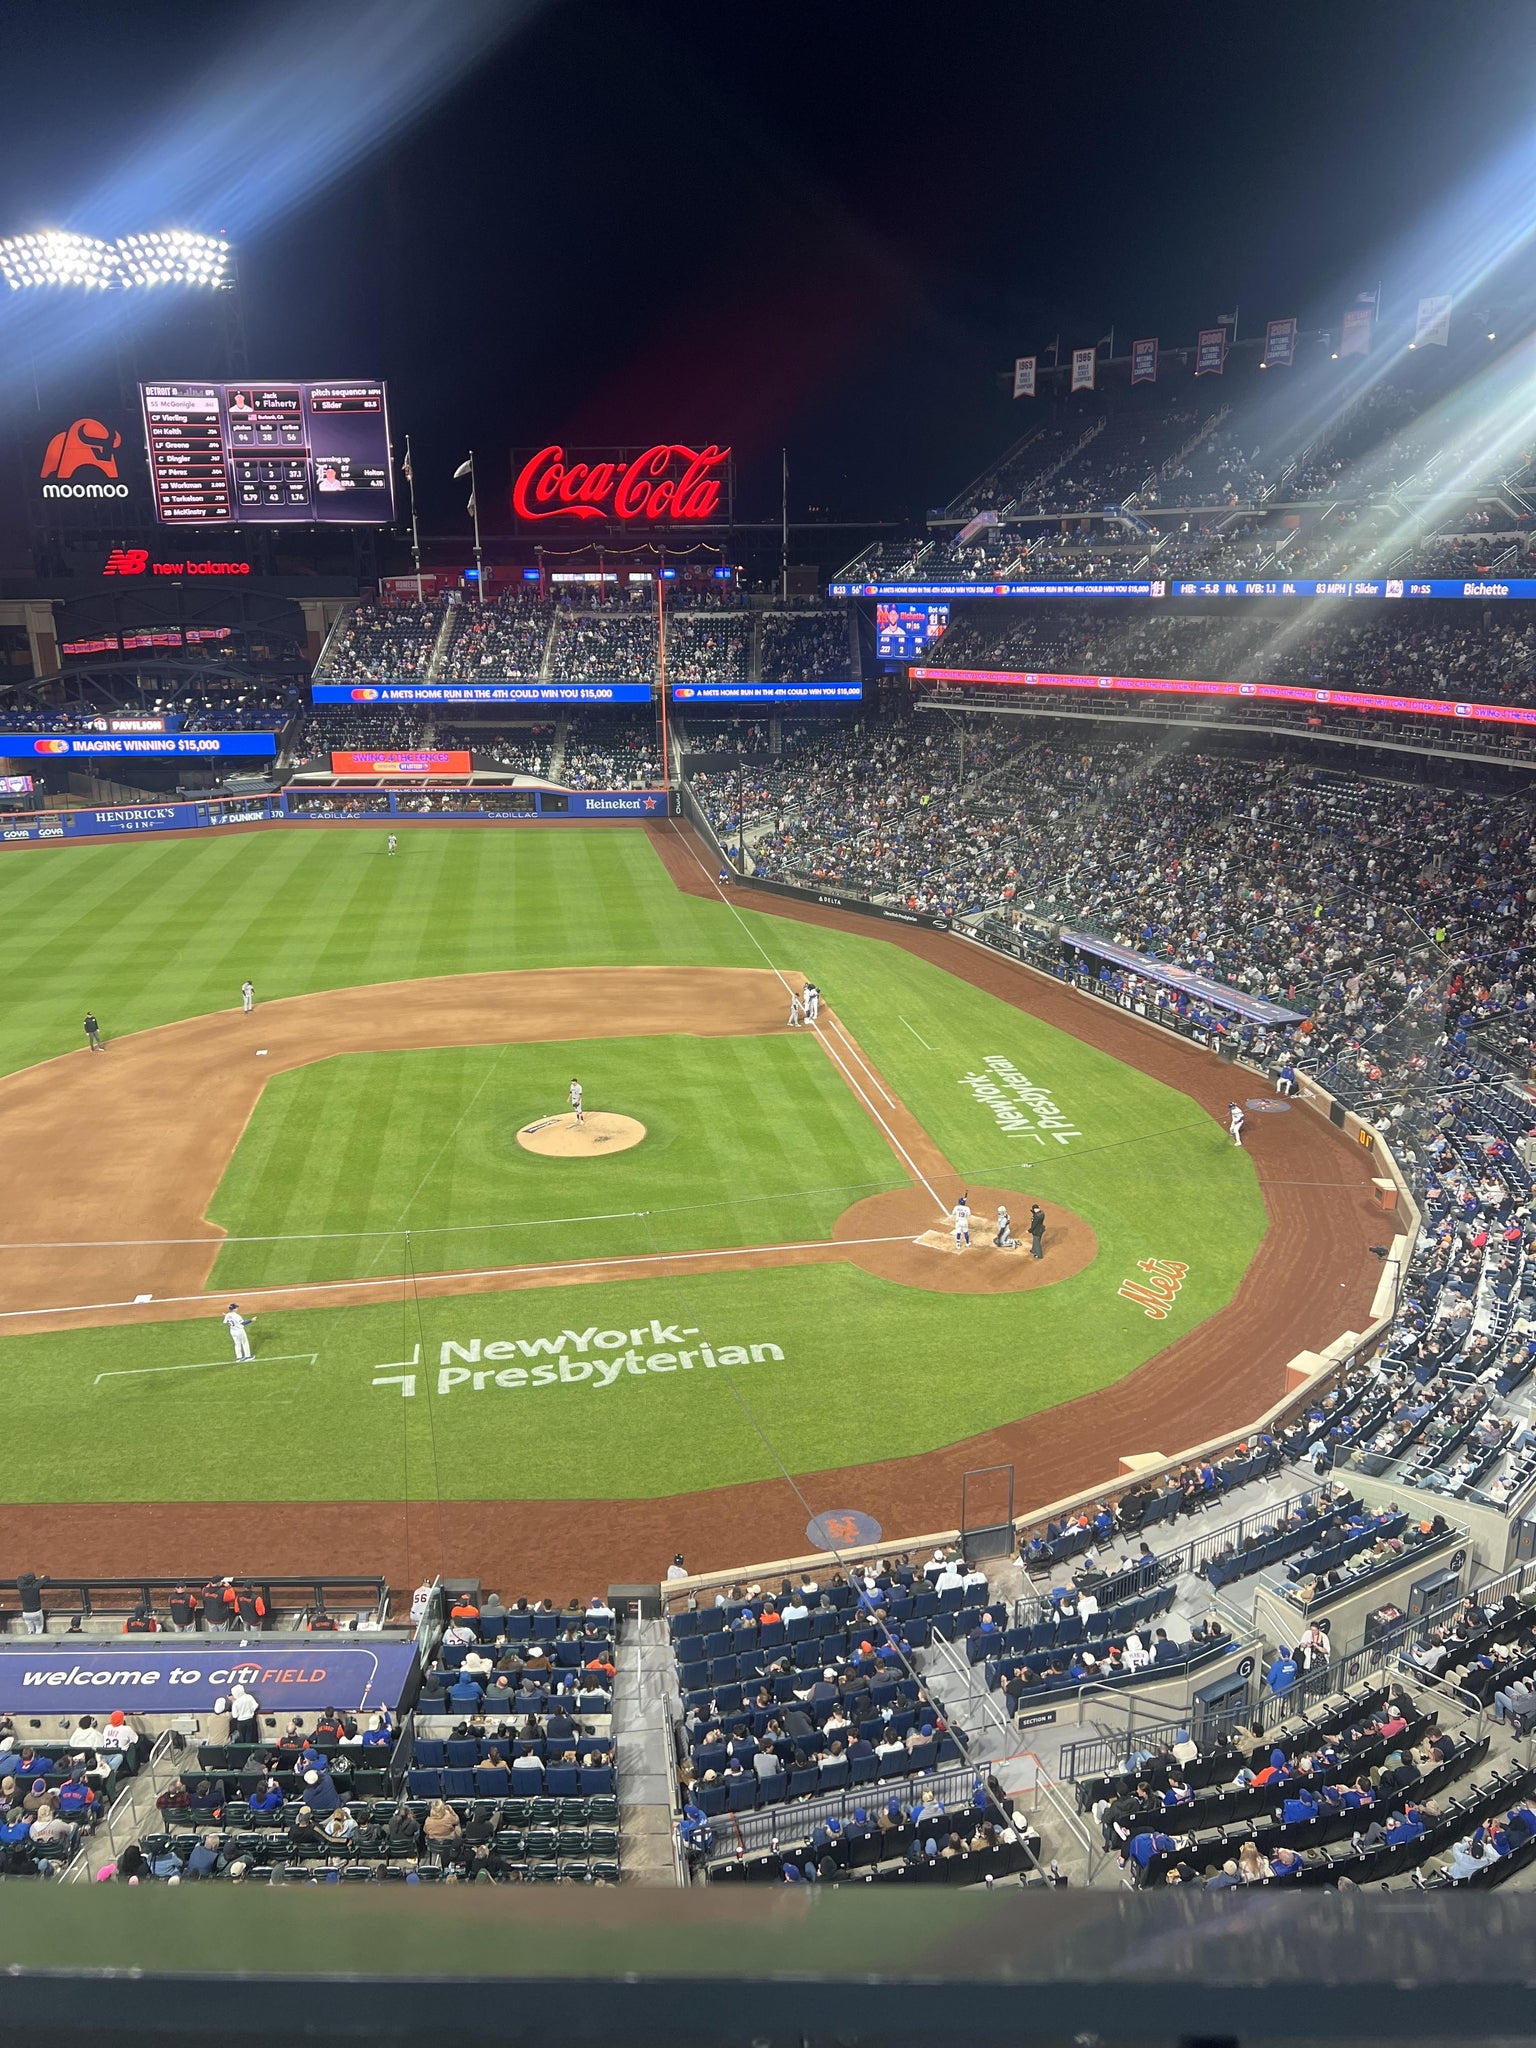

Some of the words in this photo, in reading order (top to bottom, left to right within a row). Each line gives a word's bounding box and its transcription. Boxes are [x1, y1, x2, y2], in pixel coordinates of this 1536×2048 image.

[146, 387, 170, 395] DETROIT
[311, 389, 330, 398] pitch
[332, 389, 367, 397] sequence
[160, 401, 195, 409] McGonigle
[263, 400, 297, 409] Flaherty
[162, 415, 187, 423] Vierling
[513, 445, 731, 520] Coca-Cola
[43, 484, 129, 498] moomoo
[152, 563, 183, 574] new
[187, 561, 250, 575] balance
[833, 586, 846, 594] 8:33
[1181, 585, 1196, 594] HB:
[1225, 585, 1238, 594] IN.
[1283, 584, 1296, 594] IN.
[1316, 584, 1327, 594] 83
[1327, 584, 1346, 594] MPH
[1355, 584, 1379, 594] Slider
[1463, 584, 1508, 595] Bichette
[382, 690, 389, 699] A
[390, 690, 414, 699] METS
[415, 690, 442, 699] HOME
[444, 690, 462, 698] RUN
[464, 690, 473, 698] IN
[474, 690, 491, 698] THE
[492, 689, 508, 698] 4TH
[510, 689, 539, 698] COULD
[541, 689, 560, 698] WIN
[560, 689, 578, 698] YOU
[580, 689, 612, 699] $15,000
[703, 689, 719, 697] METS
[774, 688, 787, 696] 4TH
[787, 688, 808, 696] COULD
[809, 688, 822, 696] WIN
[837, 688, 860, 696] $15,000
[112, 721, 162, 730] PAVILION
[73, 741, 122, 751] IMAGINE
[124, 740, 176, 751] WINNING
[178, 740, 220, 752] $15,000
[353, 753, 386, 762] SWING
[395, 753, 413, 762] THE
[414, 753, 449, 762] FENCES
[586, 798, 640, 810] Heineken
[96, 808, 175, 822] HENDRICK'S
[229, 812, 263, 823] DUNKIN'
[3, 830, 29, 838] GOYA
[38, 828, 64, 836] GOYA
[824, 896, 842, 905] DELTA
[982, 1055, 1075, 1129] Presbyterian
[1117, 1258, 1190, 1319] Mets
[440, 1320, 699, 1366] NewYork-
[438, 1342, 785, 1395] Presbyterian
[414, 1594, 427, 1603] 56
[1240, 1661, 1251, 1676] G
[22, 1666, 160, 1686] welcome
[169, 1667, 201, 1685] to
[208, 1663, 263, 1685] citi
[262, 1669, 327, 1683] FIELD
[1023, 1716, 1046, 1726] SECTION
